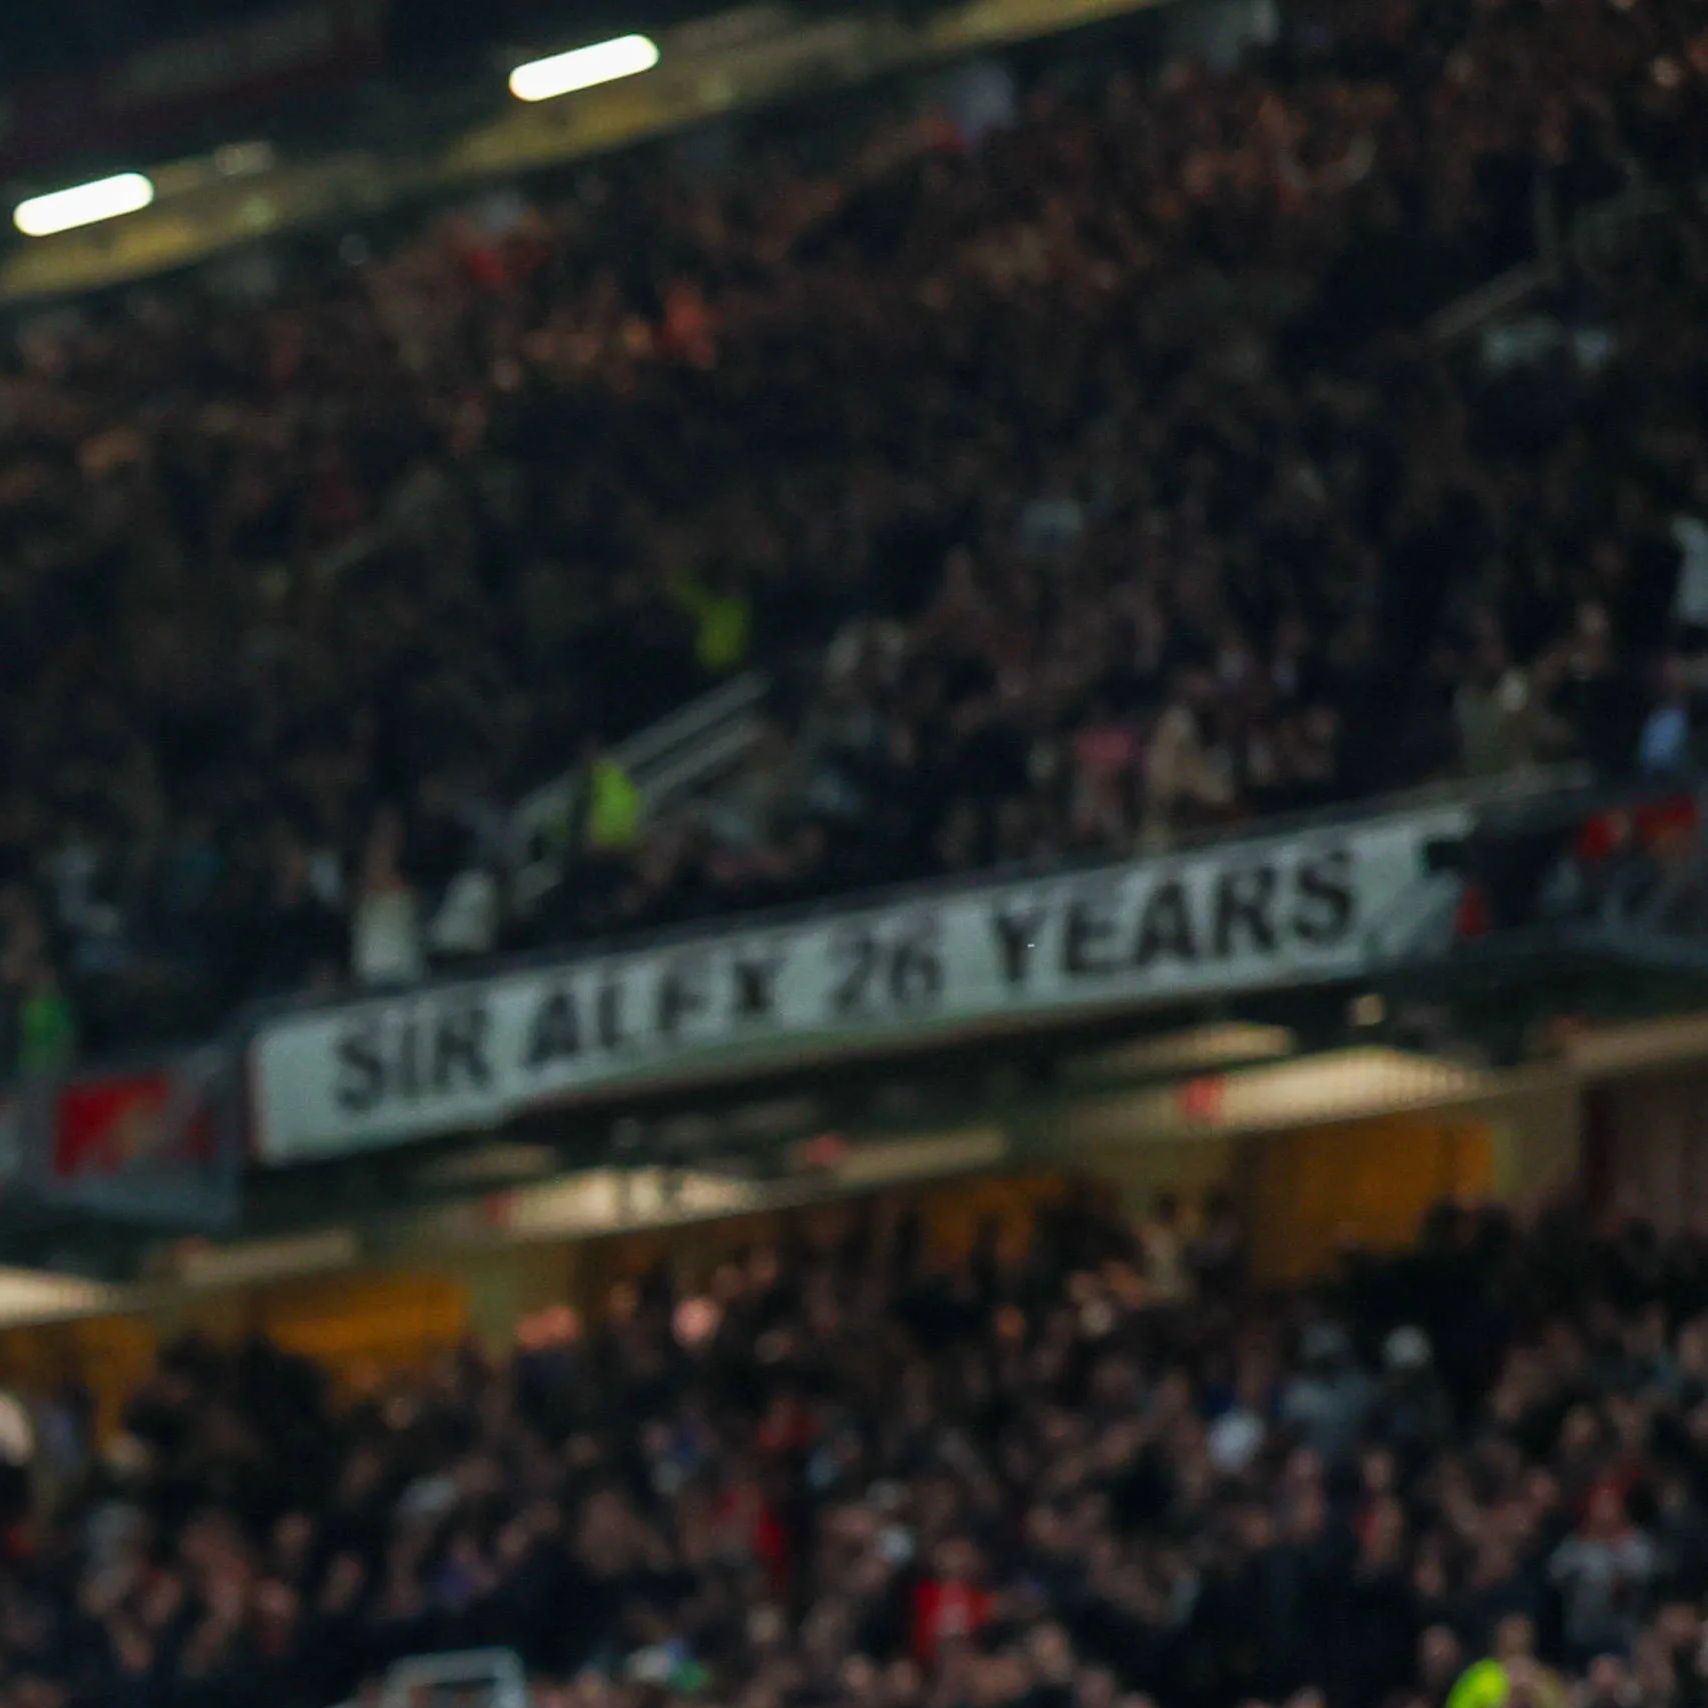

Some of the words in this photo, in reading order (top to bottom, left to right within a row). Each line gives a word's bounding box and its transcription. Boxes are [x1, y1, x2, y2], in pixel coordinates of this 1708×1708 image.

[331, 1006, 491, 1112] SIR
[521, 962, 781, 1071] ALEX
[828, 920, 942, 1008] 26
[989, 846, 1354, 984] YEARS
